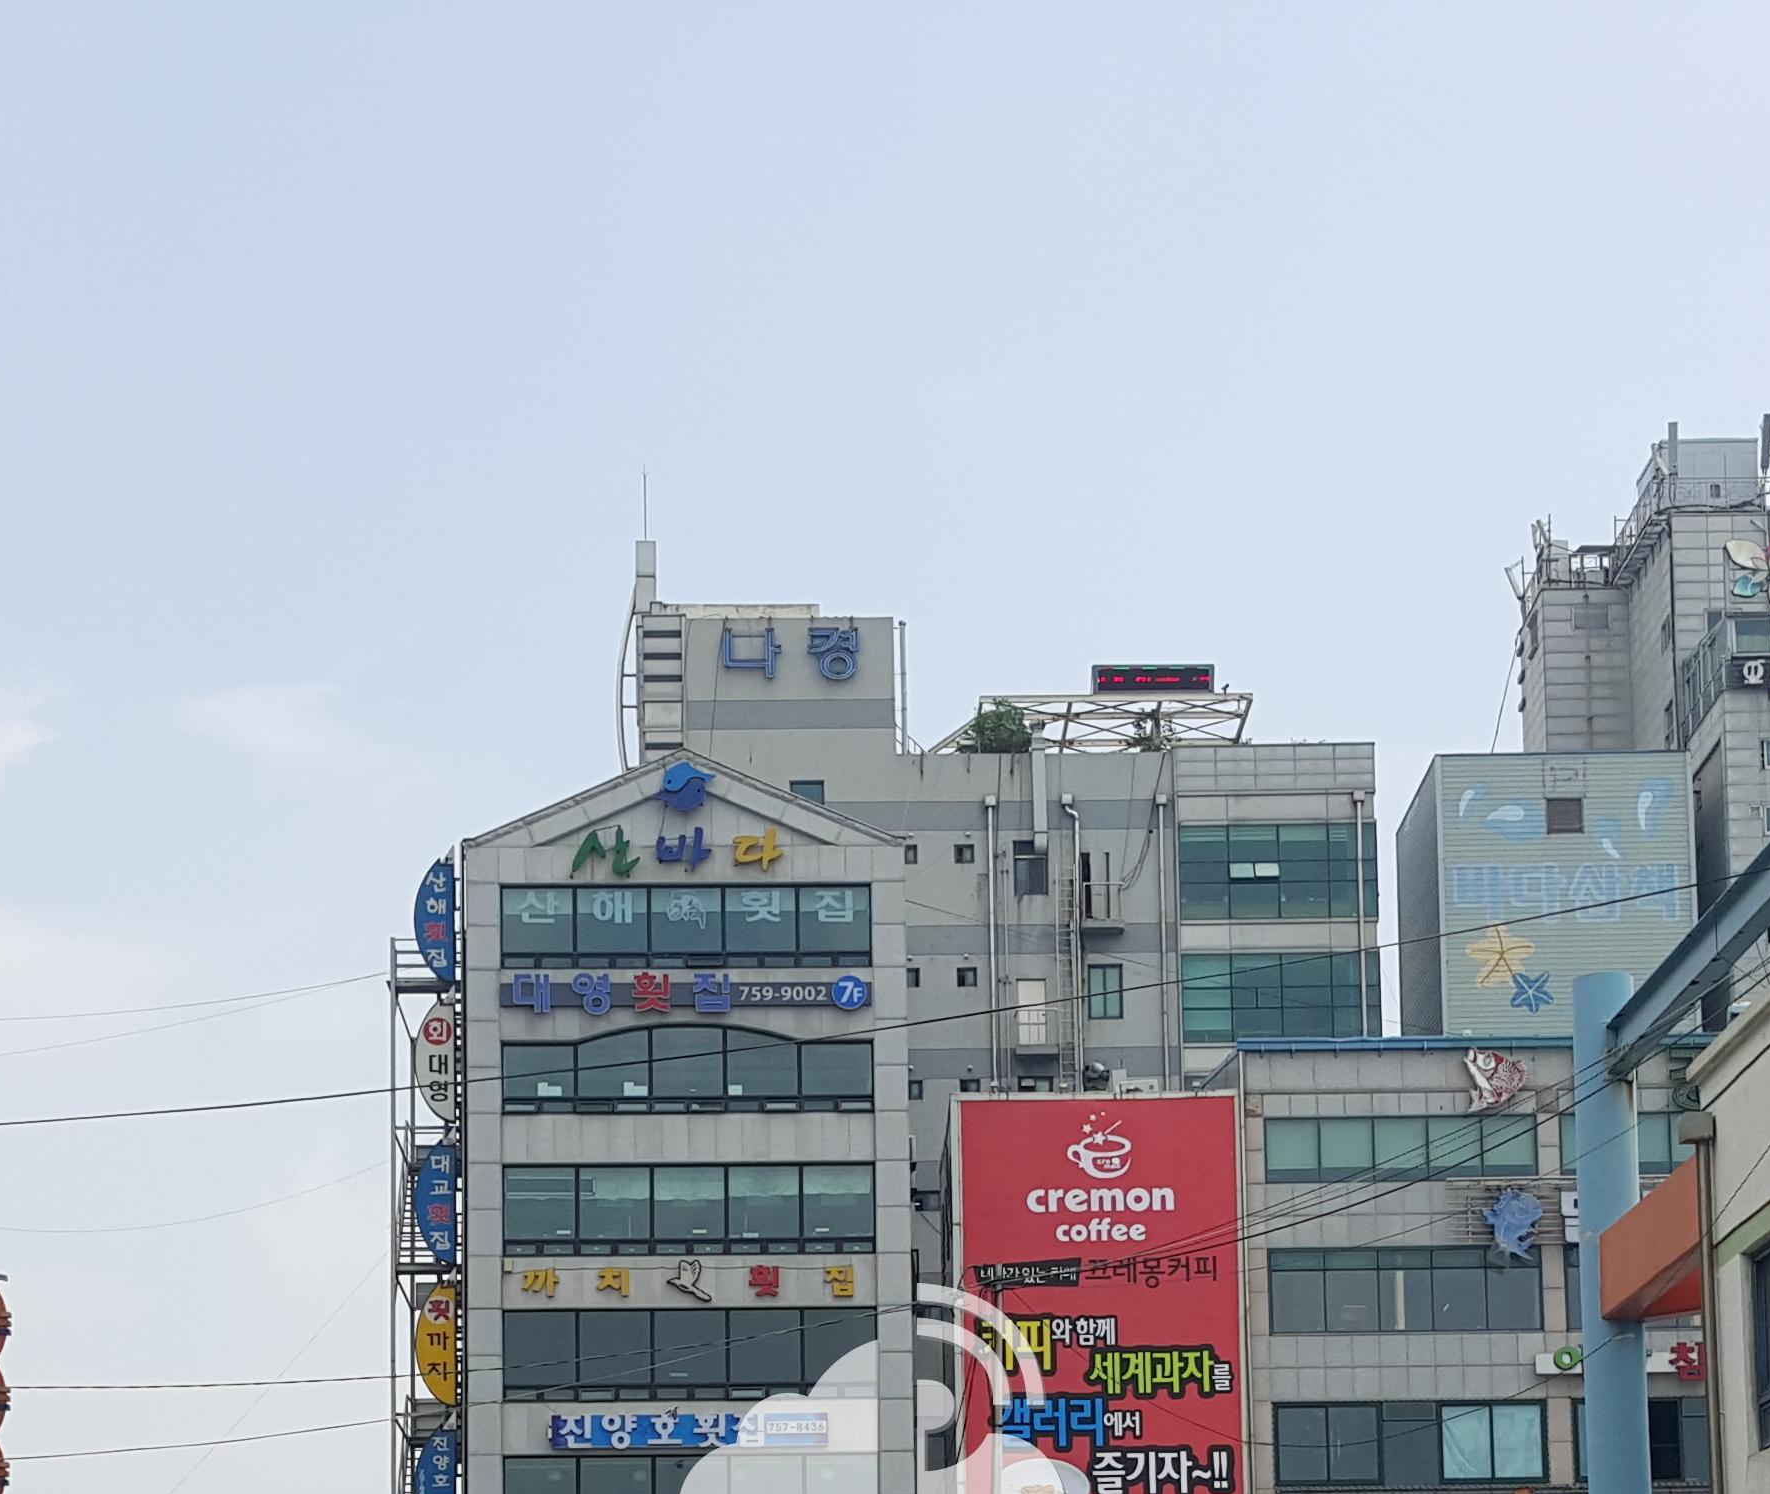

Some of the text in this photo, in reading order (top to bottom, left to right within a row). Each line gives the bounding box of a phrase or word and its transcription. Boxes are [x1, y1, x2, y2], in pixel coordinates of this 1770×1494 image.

[723, 626, 860, 681] 나경
[569, 824, 787, 878] 산바다
[738, 984, 828, 1002] 759-9002
[836, 979, 866, 1005] 7F
[428, 1054, 449, 1104] 대영
[426, 1151, 452, 1252] 대교횟집
[1026, 1186, 1175, 1213] cremon
[1055, 1217, 1147, 1242] coffee
[978, 1316, 1117, 1372] 커피와 함께
[1089, 1349, 1232, 1395] 세계과자를
[1000, 1399, 1141, 1448] 갤러리에서
